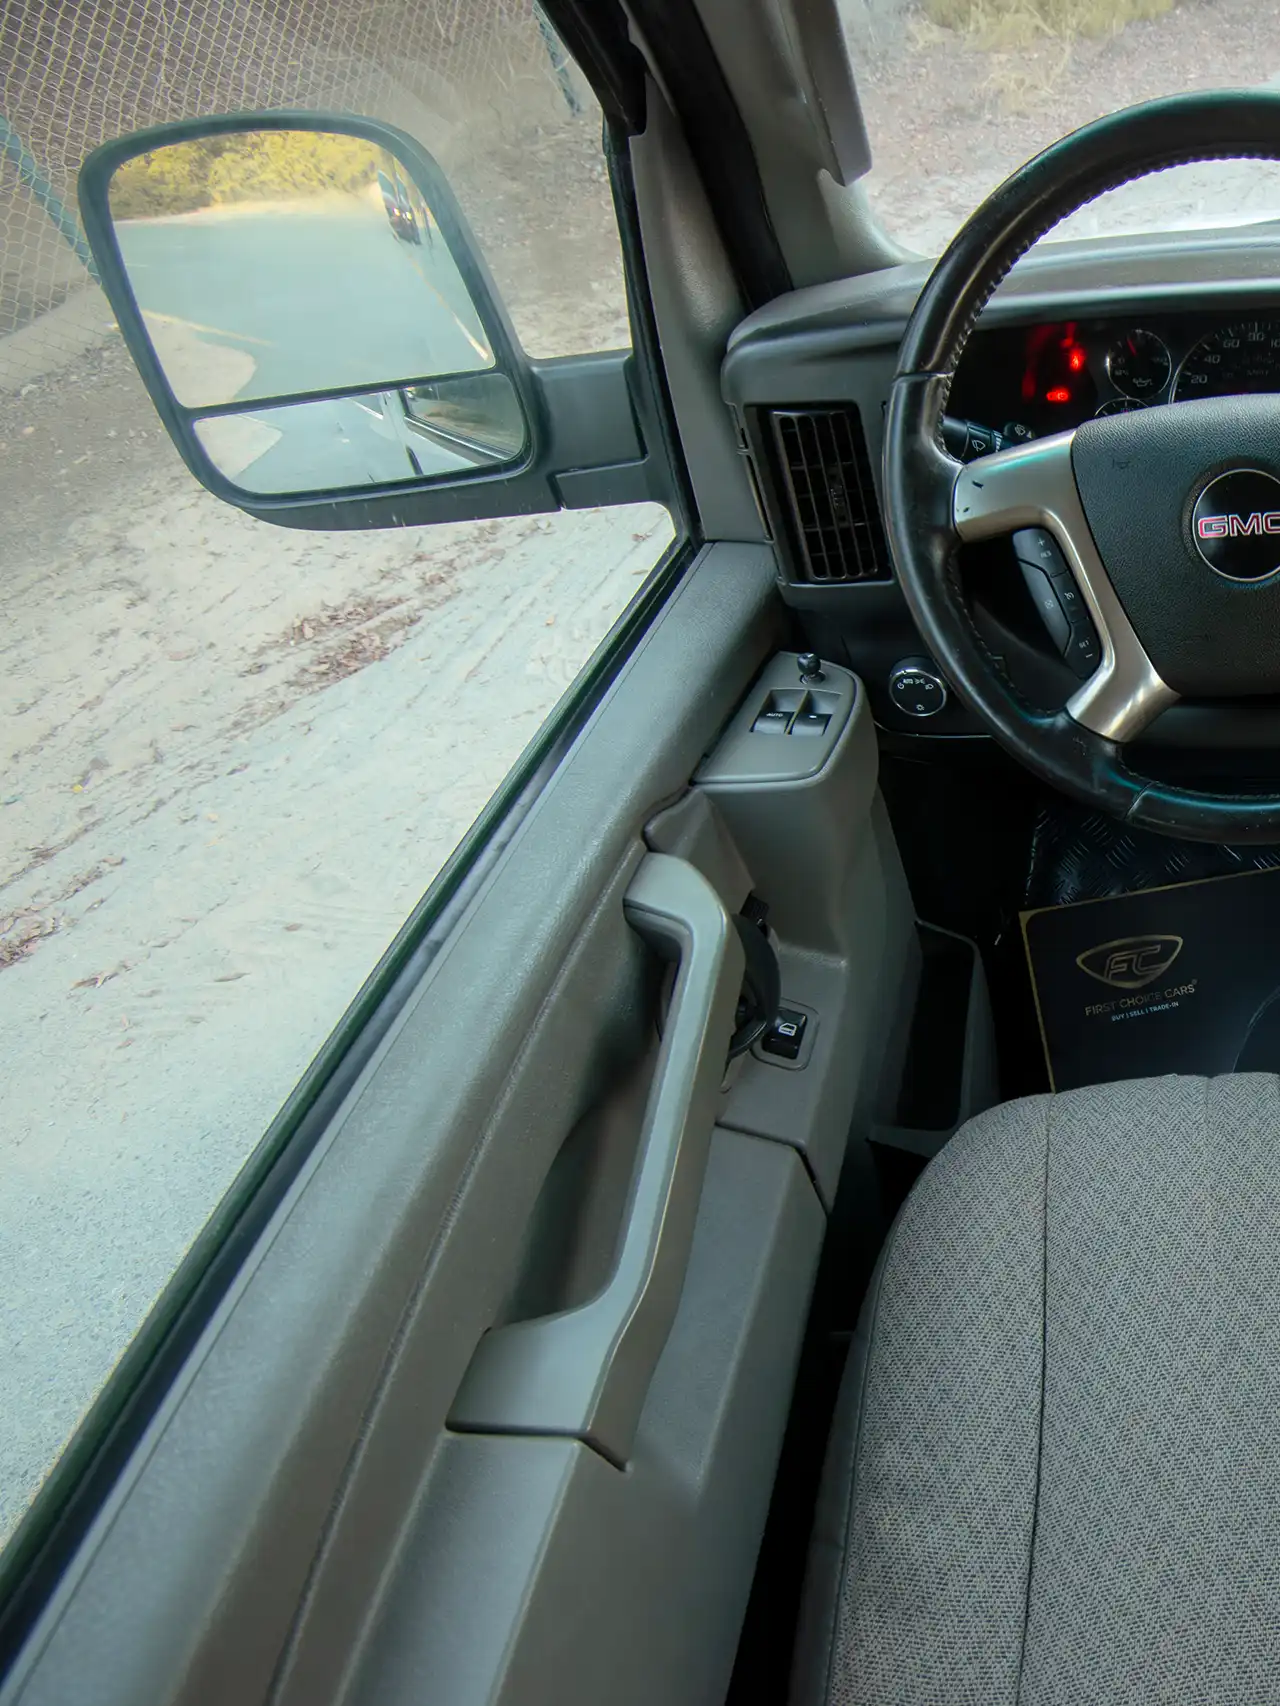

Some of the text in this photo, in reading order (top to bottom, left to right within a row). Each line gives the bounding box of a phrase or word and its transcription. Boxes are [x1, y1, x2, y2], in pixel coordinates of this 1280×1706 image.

[1203, 354, 1221, 364] 40
[1190, 374, 1208, 384] 20
[1084, 1001, 1118, 1016] FIRST
[1119, 991, 1163, 1009] CHOICE
[1111, 1001, 1179, 1022] BUY SELL TRADE-IN
